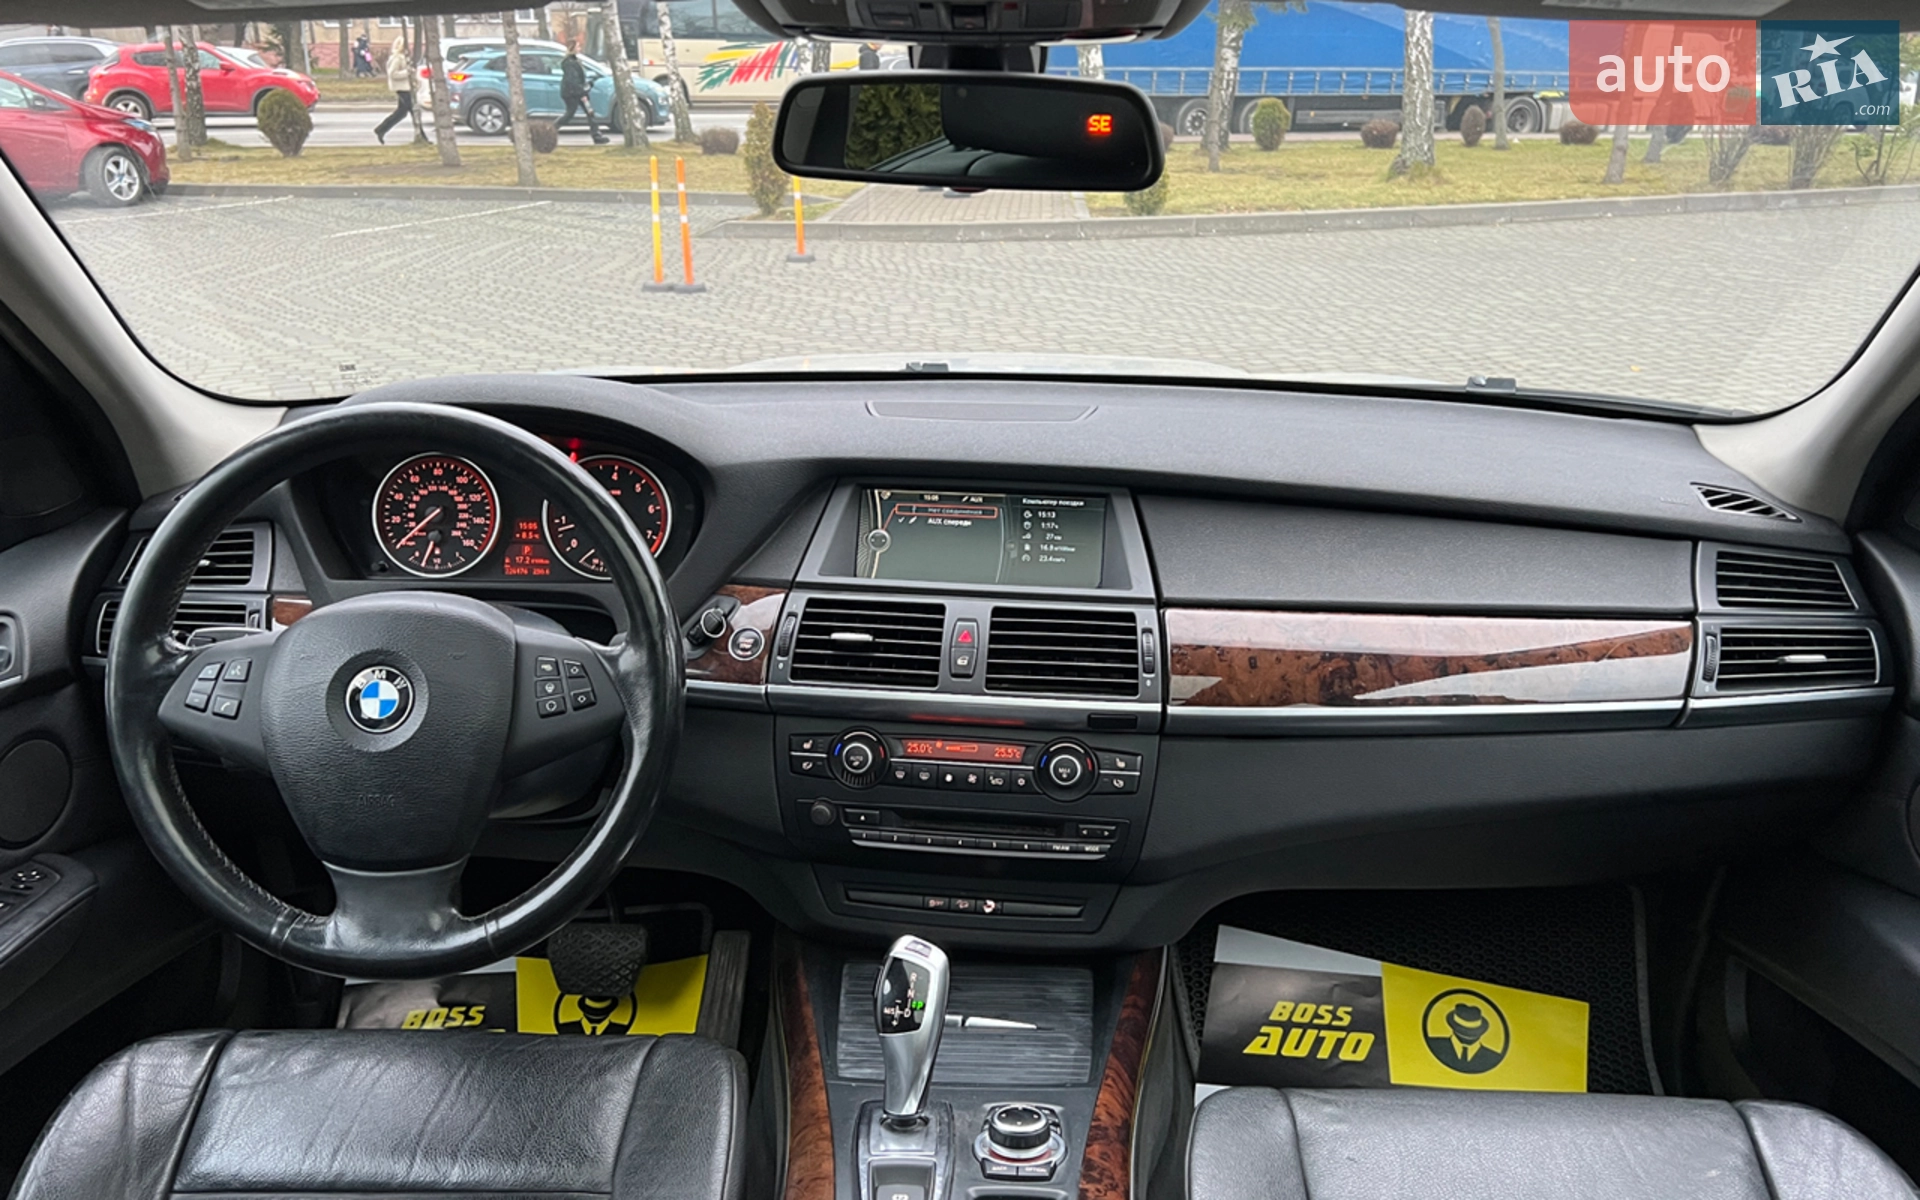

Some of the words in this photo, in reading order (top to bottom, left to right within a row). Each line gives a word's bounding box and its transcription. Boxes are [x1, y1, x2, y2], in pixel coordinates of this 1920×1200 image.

[1088, 113, 1112, 133] SE
[611, 472, 618, 480] 4
[635, 483, 641, 492] 5
[647, 504, 655, 514] 6
[561, 516, 566, 524] 1
[646, 529, 653, 539] 7
[570, 538, 578, 548] 0
[353, 669, 407, 690] BMW
[911, 971, 917, 981] R
[908, 989, 914, 999] N
[400, 1005, 486, 1030] BOSS
[1268, 1000, 1353, 1027] BOSS
[1242, 1025, 1375, 1062] AUTO
